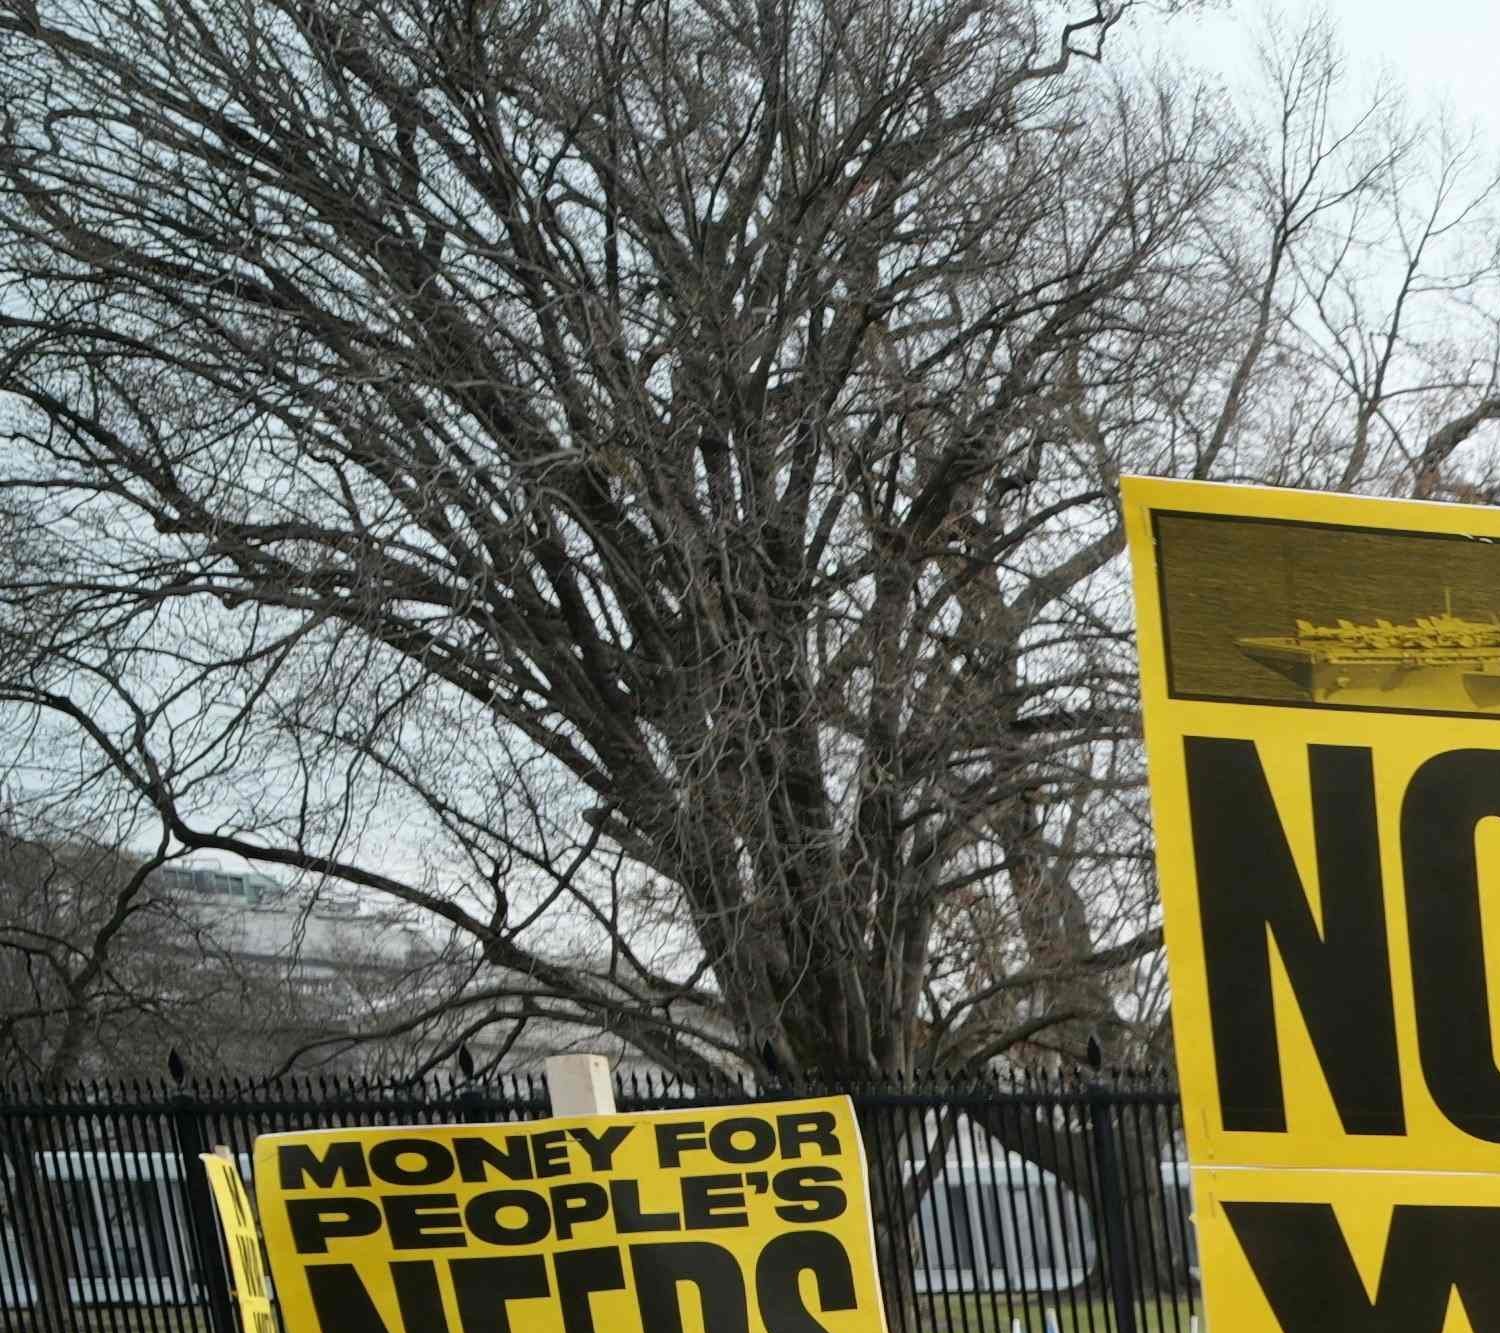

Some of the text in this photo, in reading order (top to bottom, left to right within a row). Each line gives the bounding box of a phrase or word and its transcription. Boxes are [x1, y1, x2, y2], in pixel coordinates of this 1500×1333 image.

[278, 1112, 841, 1190] MONEY FOR
[285, 1166, 847, 1254] PEOPLE'S
